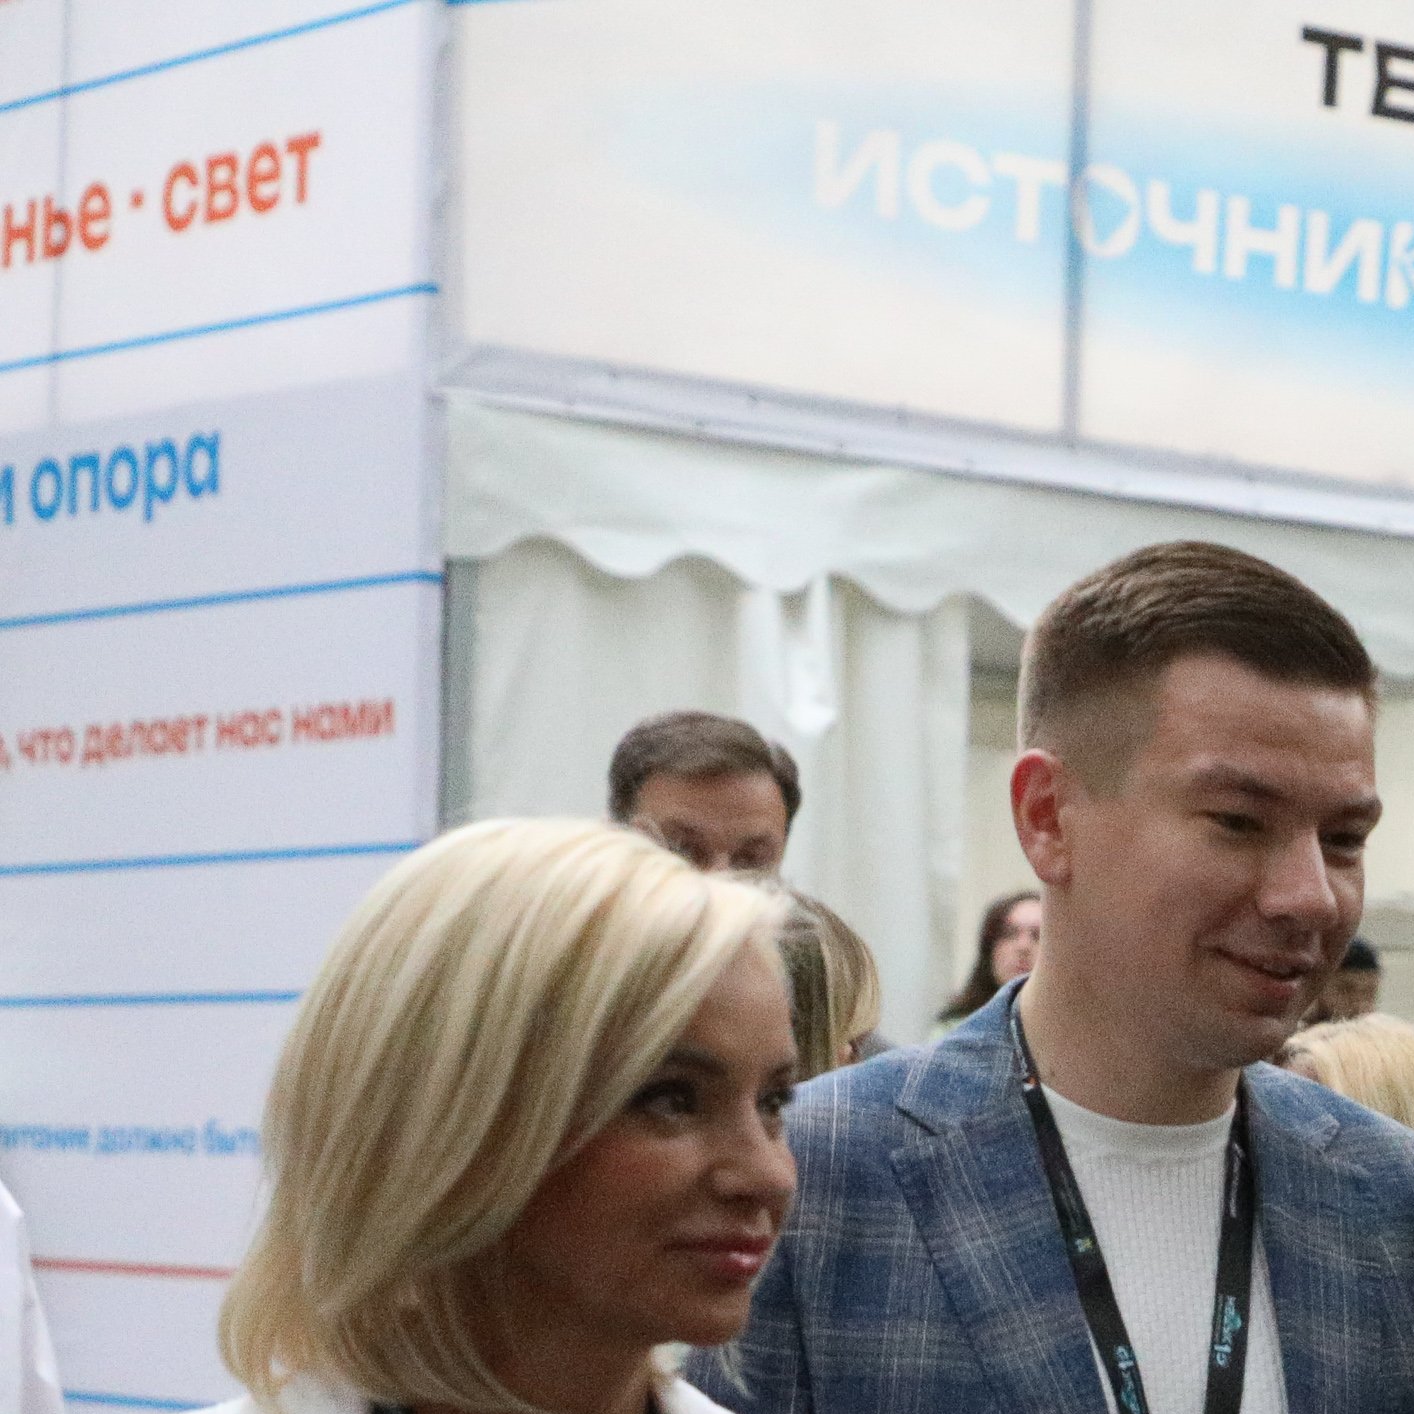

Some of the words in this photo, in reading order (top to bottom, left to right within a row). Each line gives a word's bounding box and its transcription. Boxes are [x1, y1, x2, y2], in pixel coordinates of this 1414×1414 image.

[162, 129, 321, 233] свет
[29, 430, 219, 524] опора
[17, 725, 75, 765] что
[81, 712, 208, 768] делает
[216, 707, 283, 749] нас
[291, 697, 395, 743] нами
